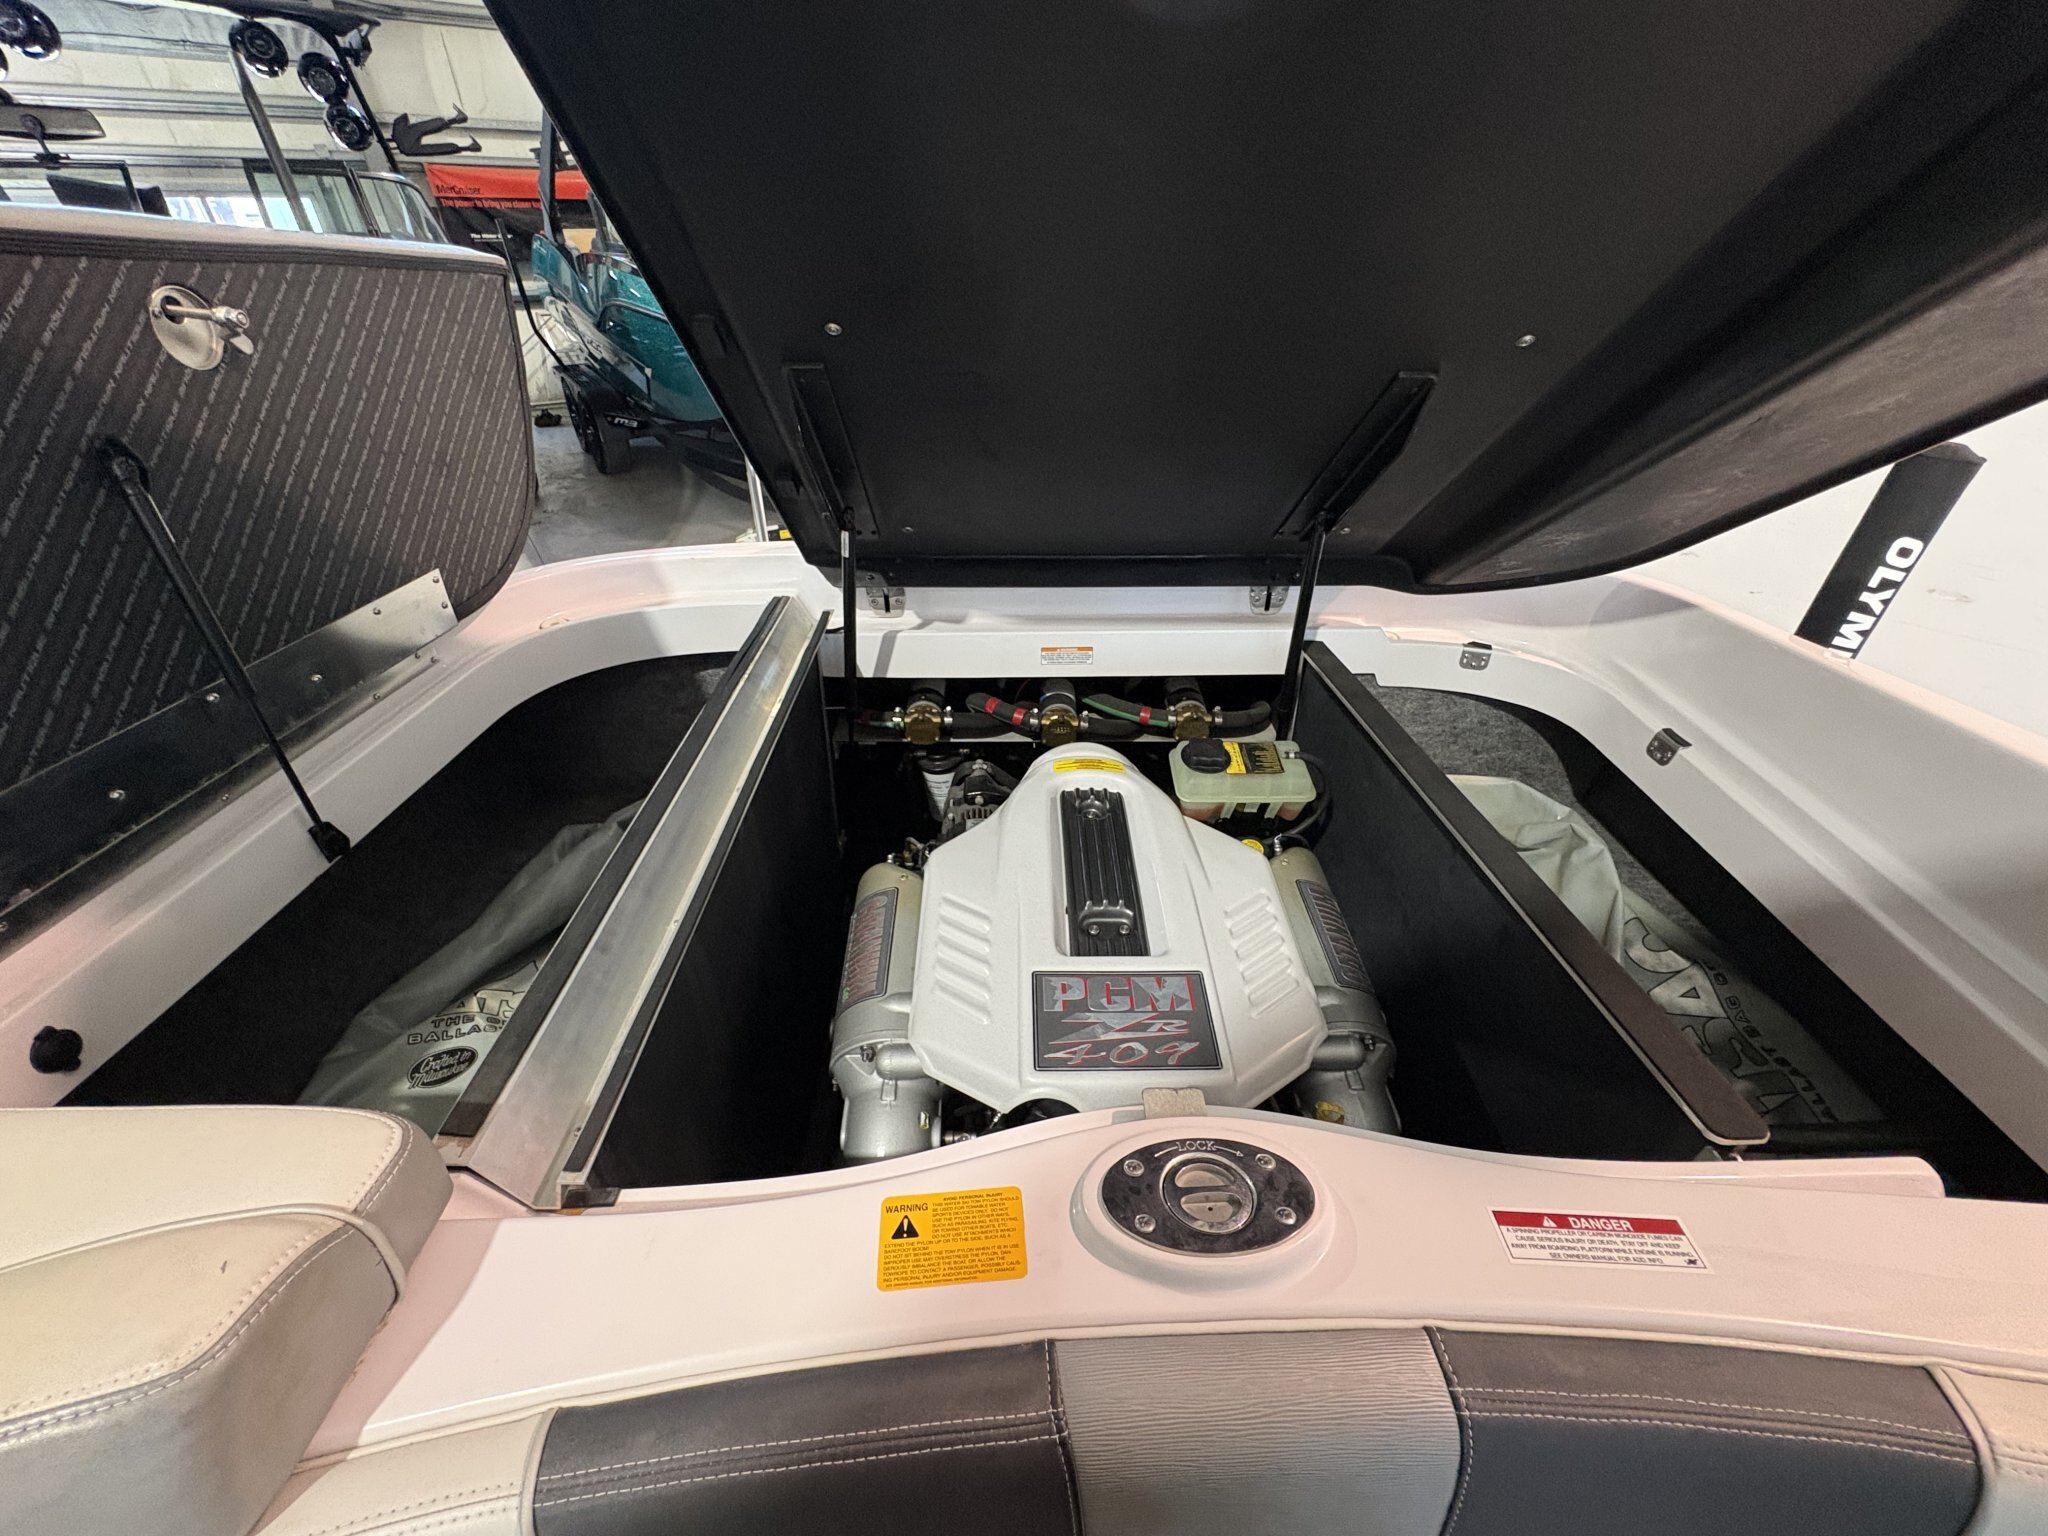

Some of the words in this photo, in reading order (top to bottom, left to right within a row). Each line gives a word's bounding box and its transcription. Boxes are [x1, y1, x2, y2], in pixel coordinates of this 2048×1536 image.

[431, 1014, 476, 1028] THE
[408, 1024, 503, 1045] BALLAS
[1176, 1140, 1216, 1152] LOCK
[886, 1203, 928, 1214] WARNING
[1569, 1217, 1634, 1231] DANGER
